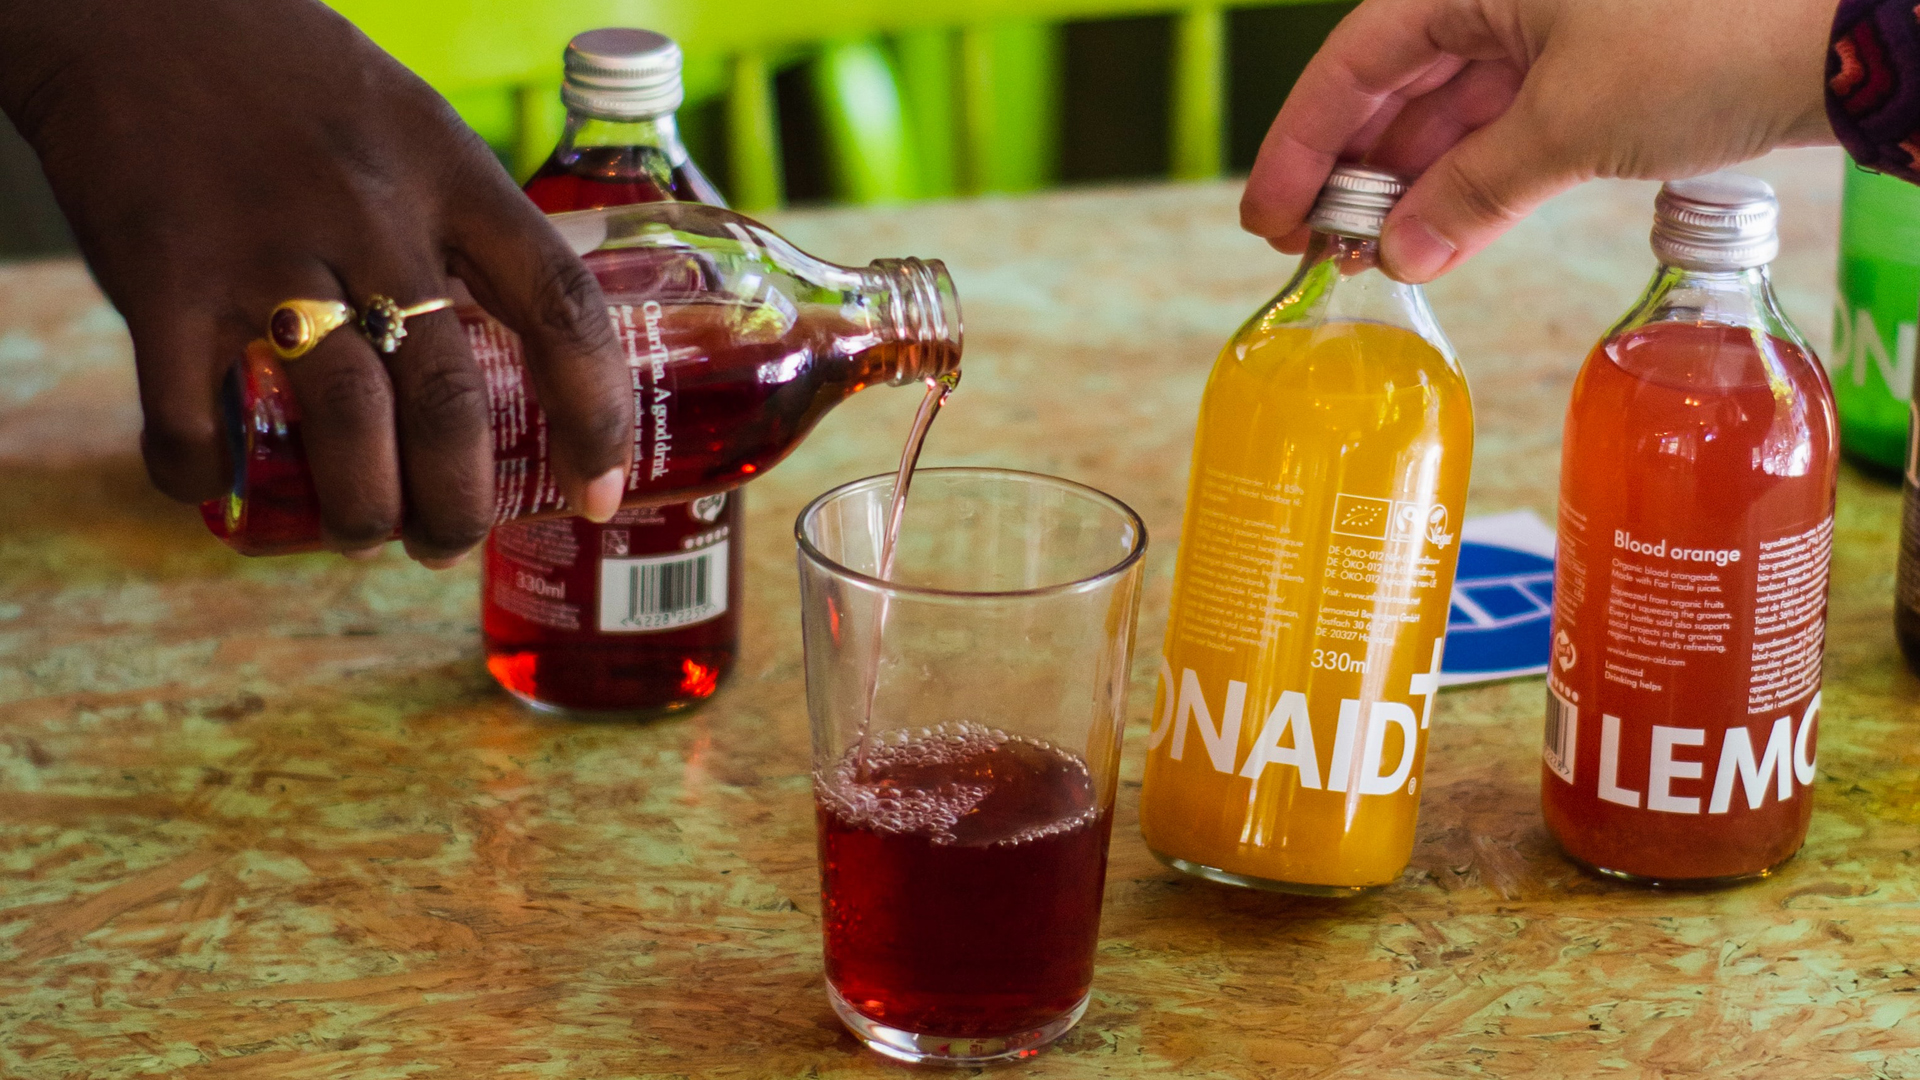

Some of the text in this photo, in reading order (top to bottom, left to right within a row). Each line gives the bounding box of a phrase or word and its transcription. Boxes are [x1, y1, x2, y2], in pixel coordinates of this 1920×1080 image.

[654, 387, 672, 403] A
[651, 404, 673, 441] good
[651, 442, 672, 481] drink.
[1328, 544, 1384, 561] DE-ÖKO-012
[1614, 528, 1667, 558] Blood
[1669, 547, 1741, 567] orange
[1324, 567, 1381, 585] DE-ÖKO-012
[1326, 556, 1383, 573] DE-ÖKO-012
[1611, 557, 1720, 584] Organic blood orangeade.
[516, 570, 566, 600] 330ml
[1322, 585, 1342, 598] Visit:
[1611, 569, 1722, 594] Made with Fair Trade juices.
[1609, 597, 1733, 622] without squeezing the growers.
[1610, 584, 1725, 610] Squeezed from organic fruits
[1317, 615, 1351, 629] Postfach
[1352, 619, 1365, 630] 30
[1318, 604, 1360, 618] Lemonaid
[1608, 605, 1731, 632] Every bottle sold also supports
[1315, 627, 1358, 642] DE-20327
[1607, 629, 1637, 643] regions.
[1637, 635, 1659, 647] Now
[1683, 642, 1727, 654] refreshing.
[1608, 618, 1723, 643] social projects in the growing
[1310, 648, 1371, 674] 330ml
[1604, 659, 1645, 678] Lemonaid
[1606, 646, 1687, 667] www.lemon-aid.com
[1604, 670, 1663, 692] Drinking helps
